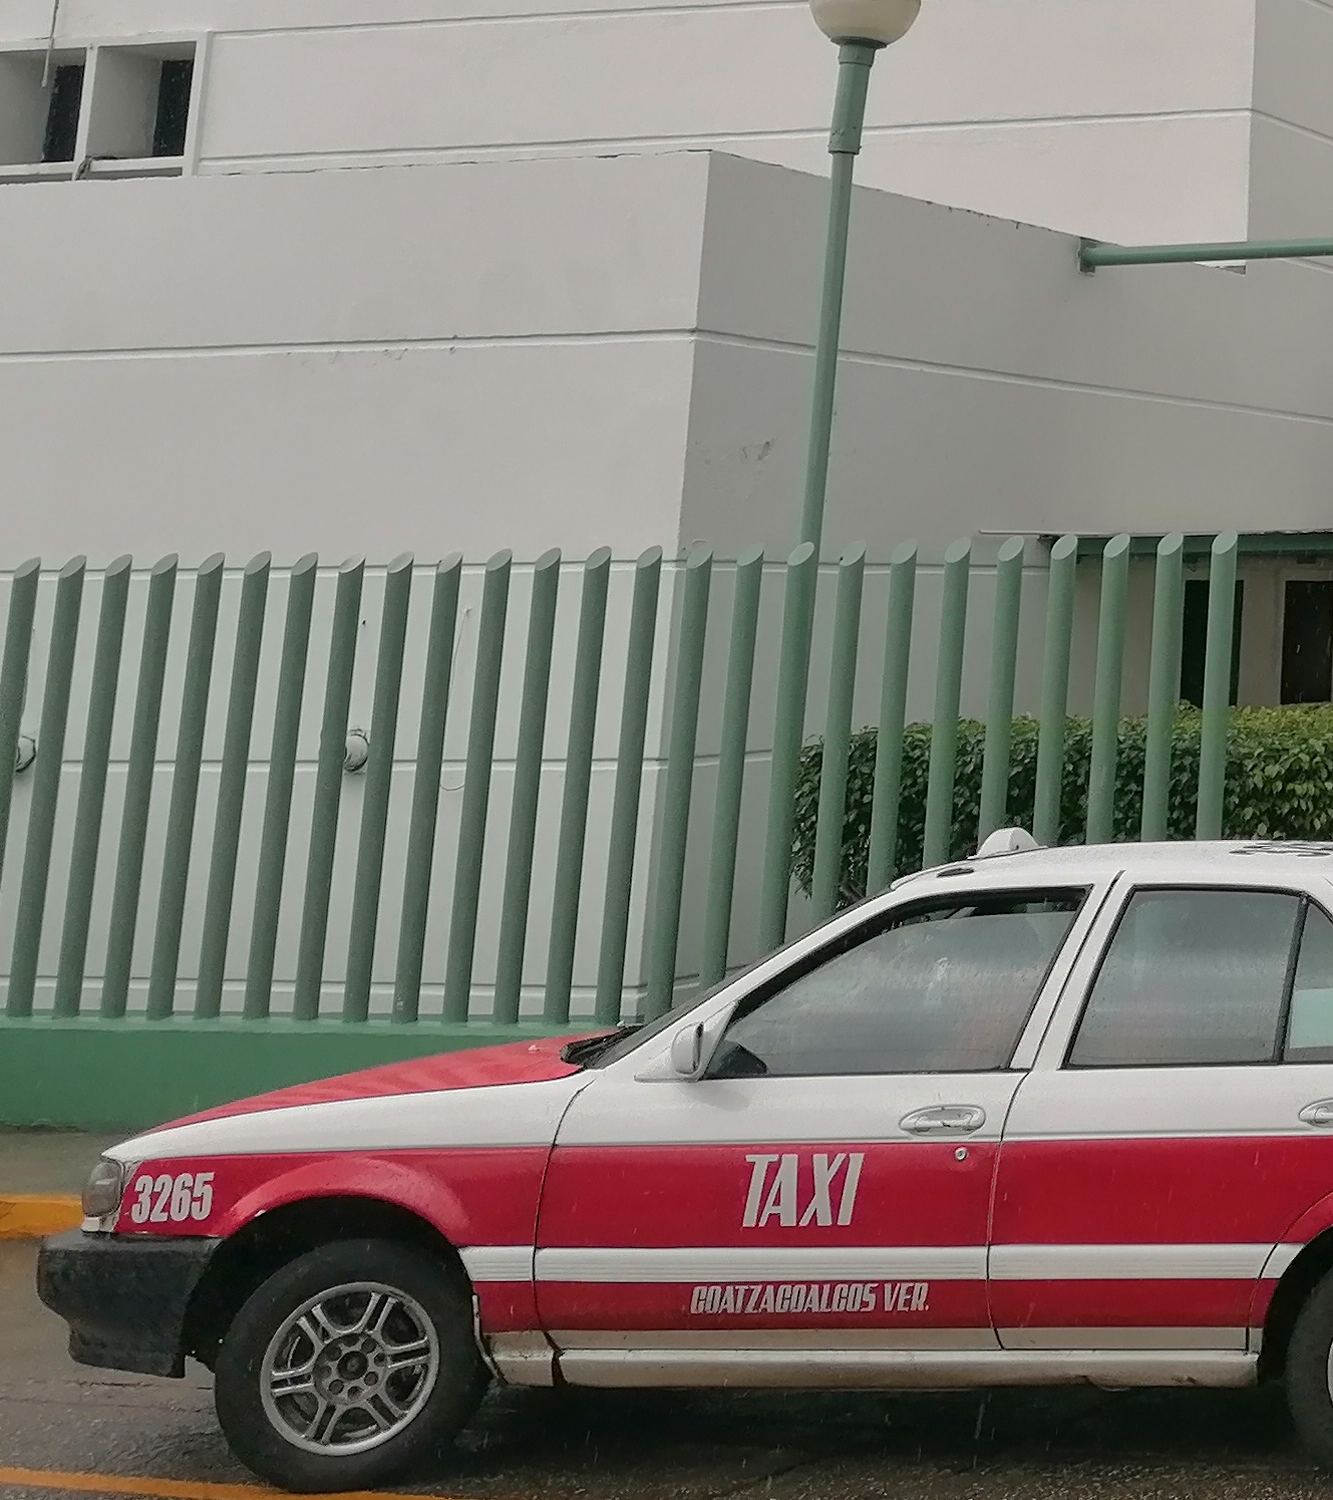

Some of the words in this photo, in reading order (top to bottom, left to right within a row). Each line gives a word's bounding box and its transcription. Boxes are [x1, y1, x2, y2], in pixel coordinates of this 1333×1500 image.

[131, 1171, 215, 1224] 3265
[743, 1153, 865, 1228] TAXI
[690, 1283, 879, 1314] COATZACOALCOS
[884, 1282, 930, 1312] VER.
